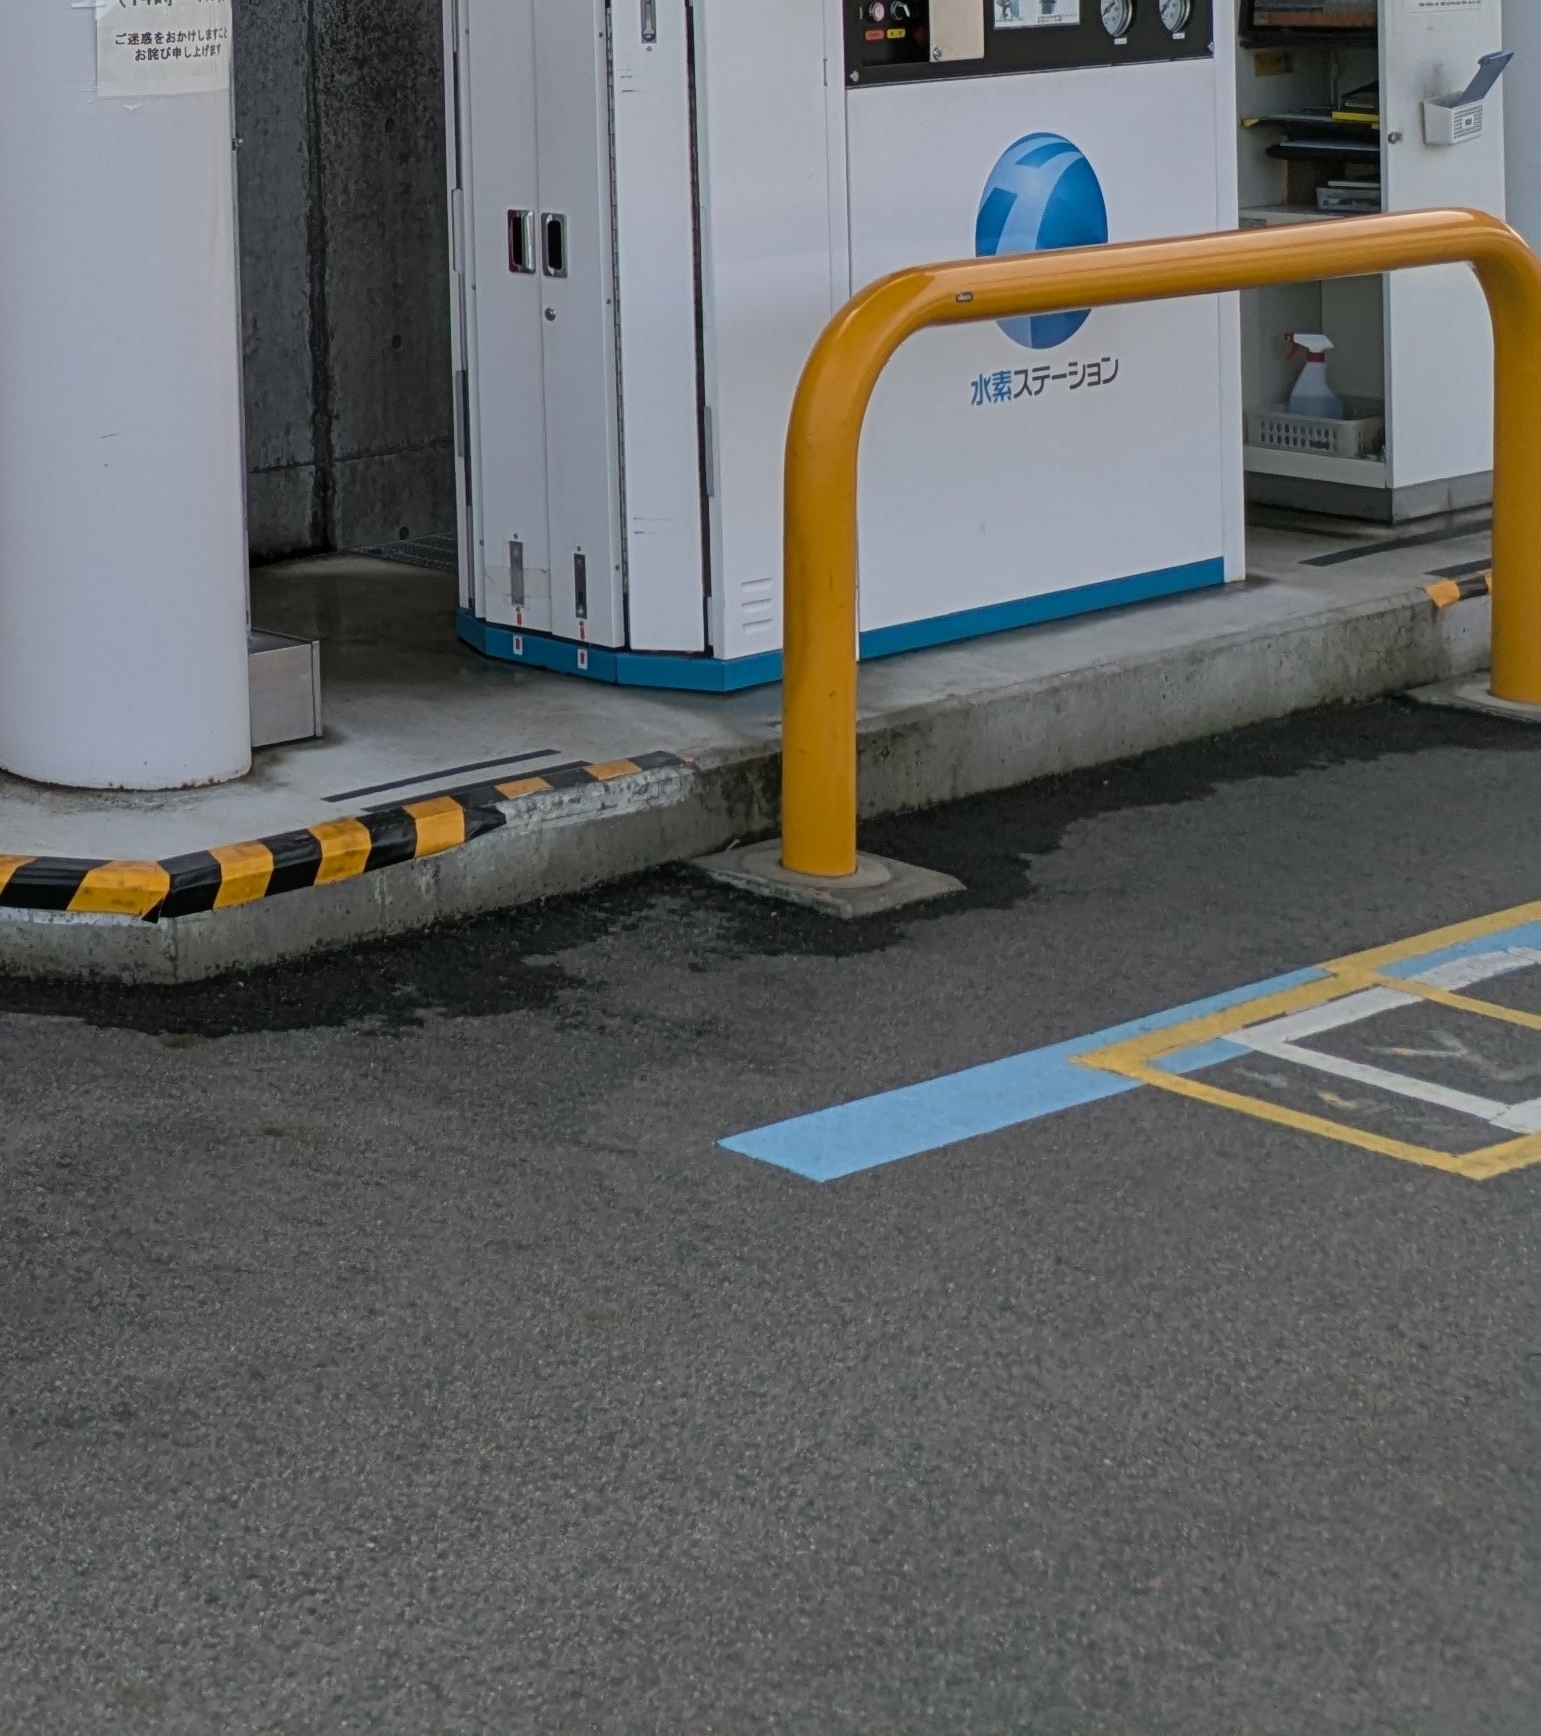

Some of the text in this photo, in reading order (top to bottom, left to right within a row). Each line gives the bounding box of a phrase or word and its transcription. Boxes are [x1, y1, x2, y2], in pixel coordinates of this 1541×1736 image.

[115, 31, 228, 45] ご迷惑をおかけしますこと
[135, 45, 221, 61] お詫び申し上げます
[970, 356, 1119, 407] 水素ステーション
